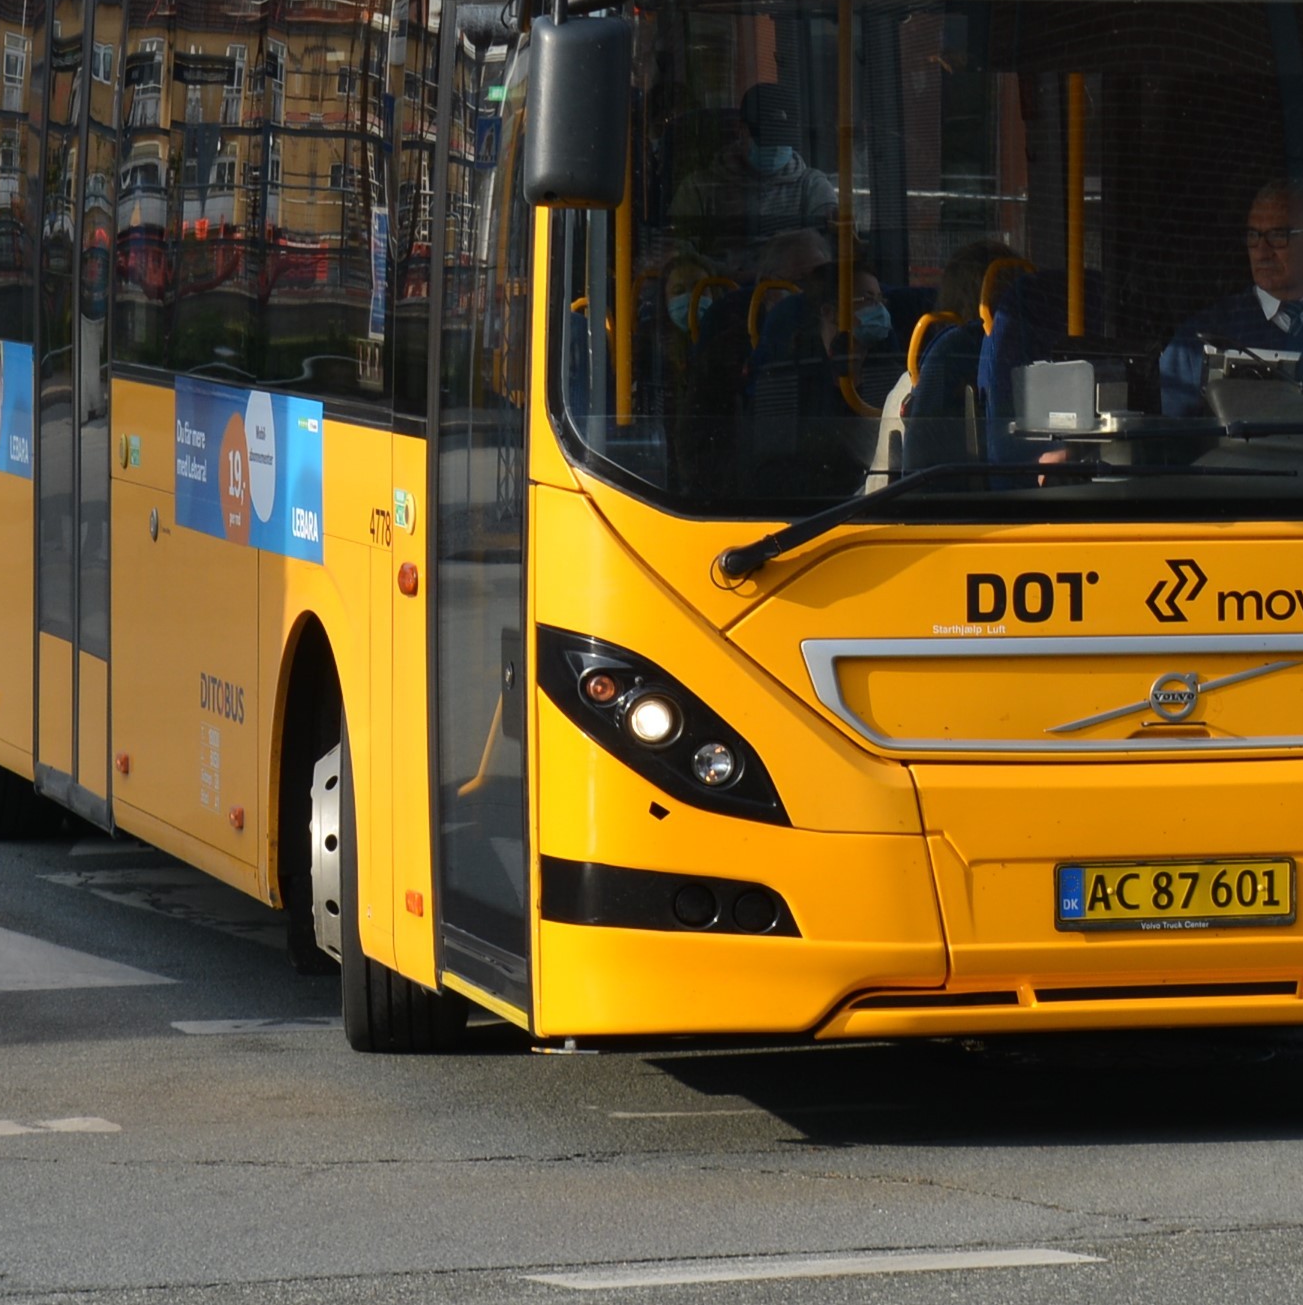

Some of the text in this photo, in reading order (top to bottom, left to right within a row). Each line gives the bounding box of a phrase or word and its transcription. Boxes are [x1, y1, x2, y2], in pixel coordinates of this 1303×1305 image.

[292, 506, 319, 543] LEBARA
[369, 507, 392, 547] 4778
[966, 571, 1099, 623] DOT
[932, 624, 1006, 636] Starthjælp Luft
[200, 672, 245, 725] DITOBUS
[1153, 692, 1195, 701] VOLVO
[1063, 899, 1079, 911] DK
[1087, 869, 1280, 911] AC 87 601
[1141, 920, 1209, 930] Volvo Truck Center
